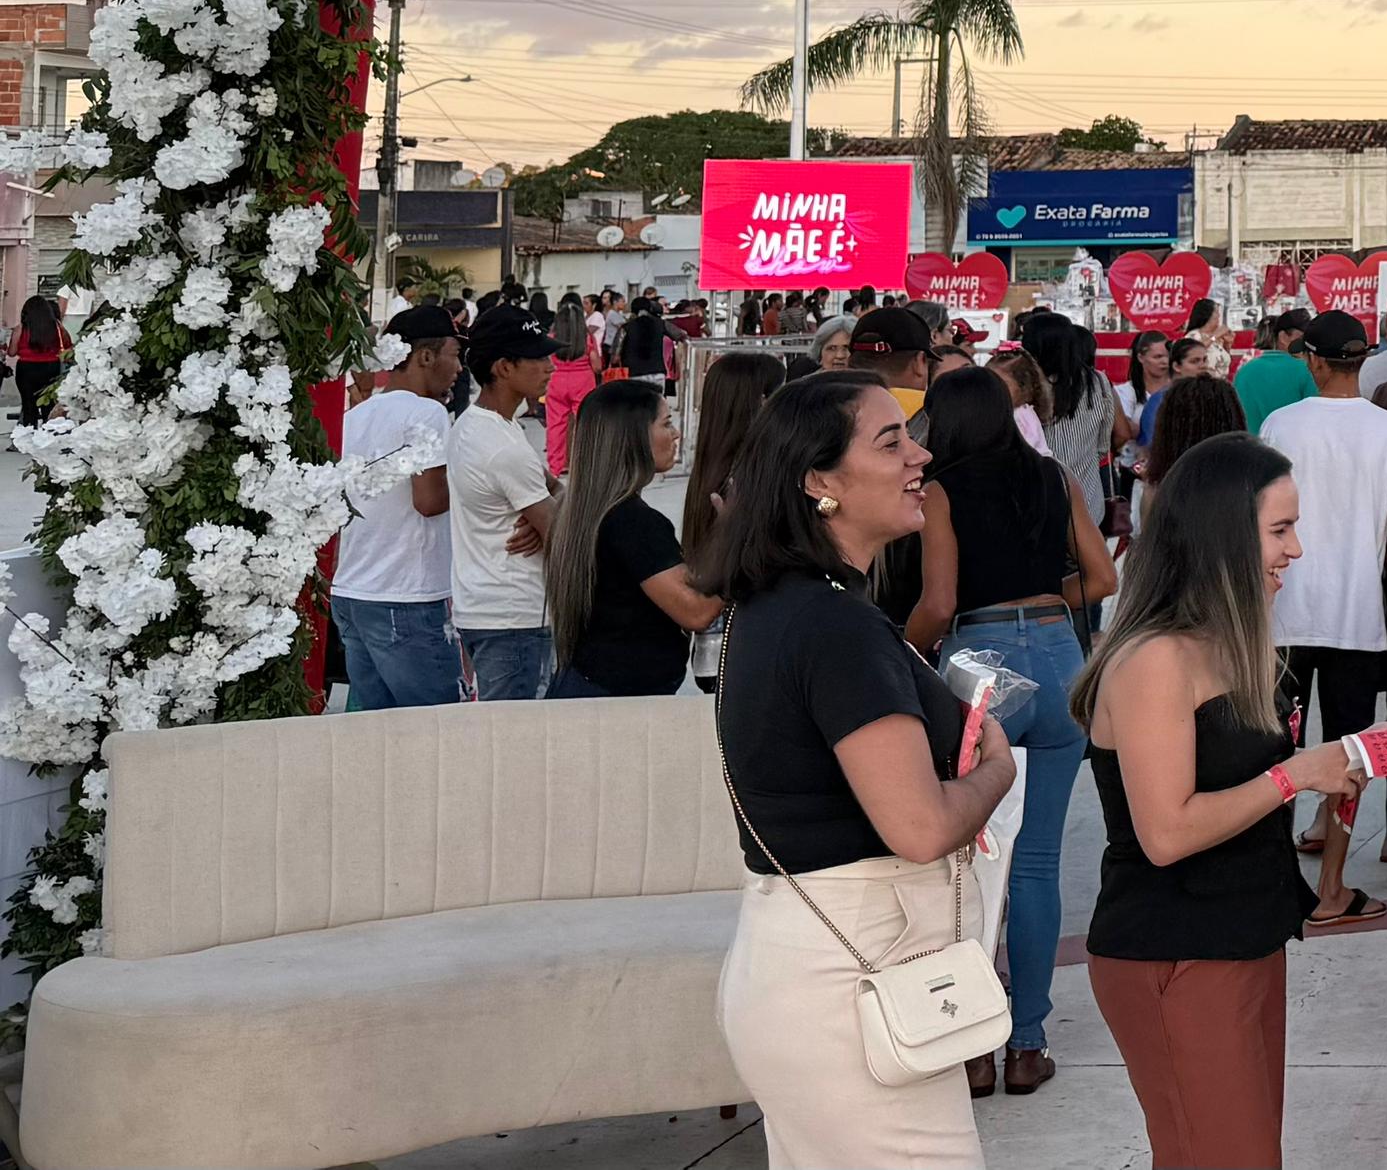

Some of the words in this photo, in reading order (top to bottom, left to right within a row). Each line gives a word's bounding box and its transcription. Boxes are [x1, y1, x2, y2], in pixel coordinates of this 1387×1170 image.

[752, 192, 846, 221] MINHA
[1034, 205, 1086, 220] Exata
[1091, 204, 1150, 219] Farma
[405, 233, 440, 242] CARIRA
[930, 274, 980, 290] MINHA
[1133, 274, 1184, 290] MINHA
